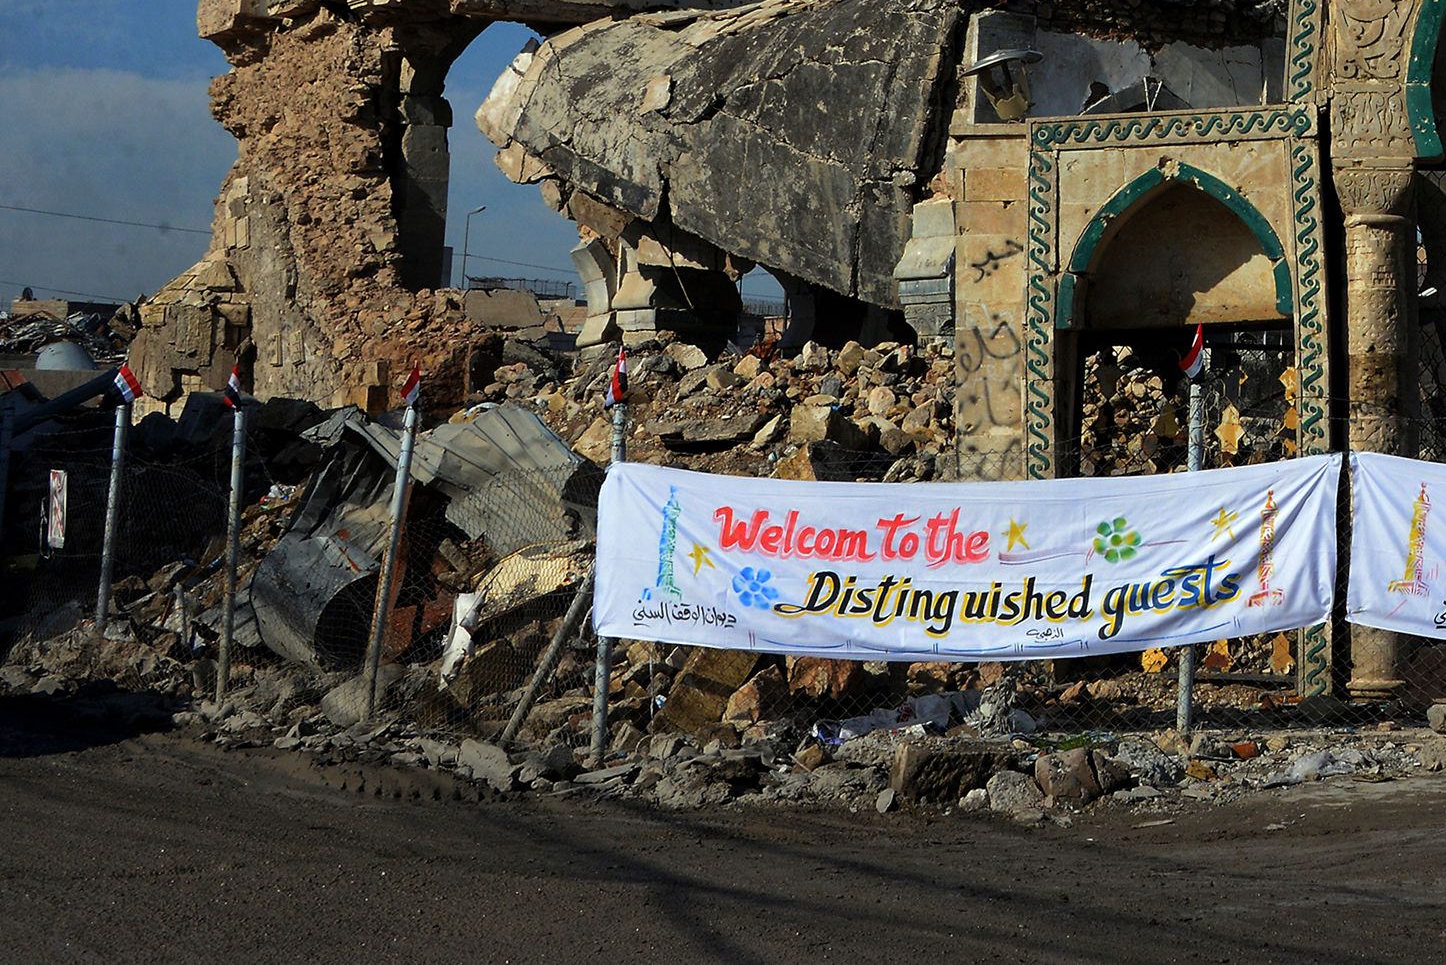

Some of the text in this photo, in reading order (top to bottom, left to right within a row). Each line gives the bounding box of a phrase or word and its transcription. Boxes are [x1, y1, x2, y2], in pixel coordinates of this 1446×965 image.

[713, 505, 993, 569] Welcom to the
[632, 599, 737, 628] ديوان الوقف السني
[1097, 553, 1242, 640] guests
